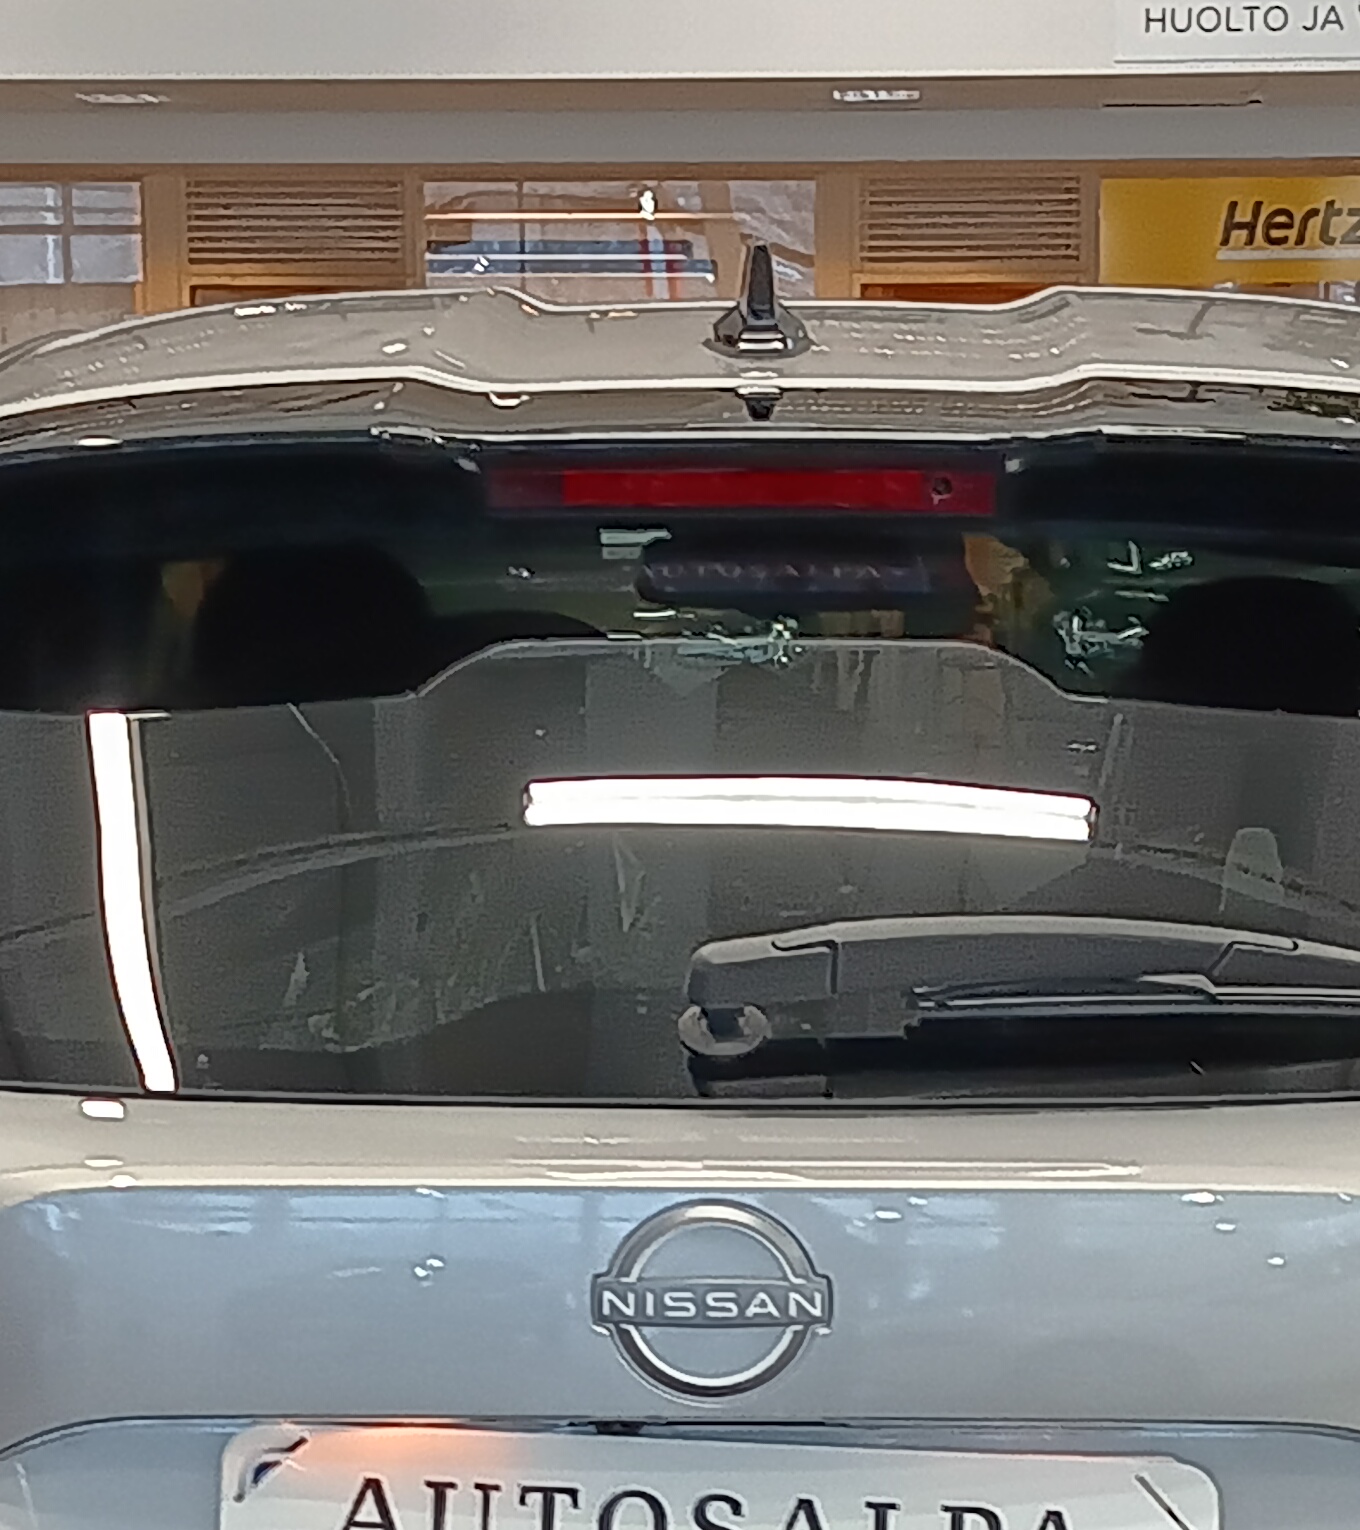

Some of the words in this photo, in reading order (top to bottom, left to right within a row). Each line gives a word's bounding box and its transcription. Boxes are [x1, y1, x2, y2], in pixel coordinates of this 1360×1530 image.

[1144, 6, 1290, 34] HUOLTO
[1302, 5, 1344, 31] JA
[601, 1290, 823, 1318] NISSAN
